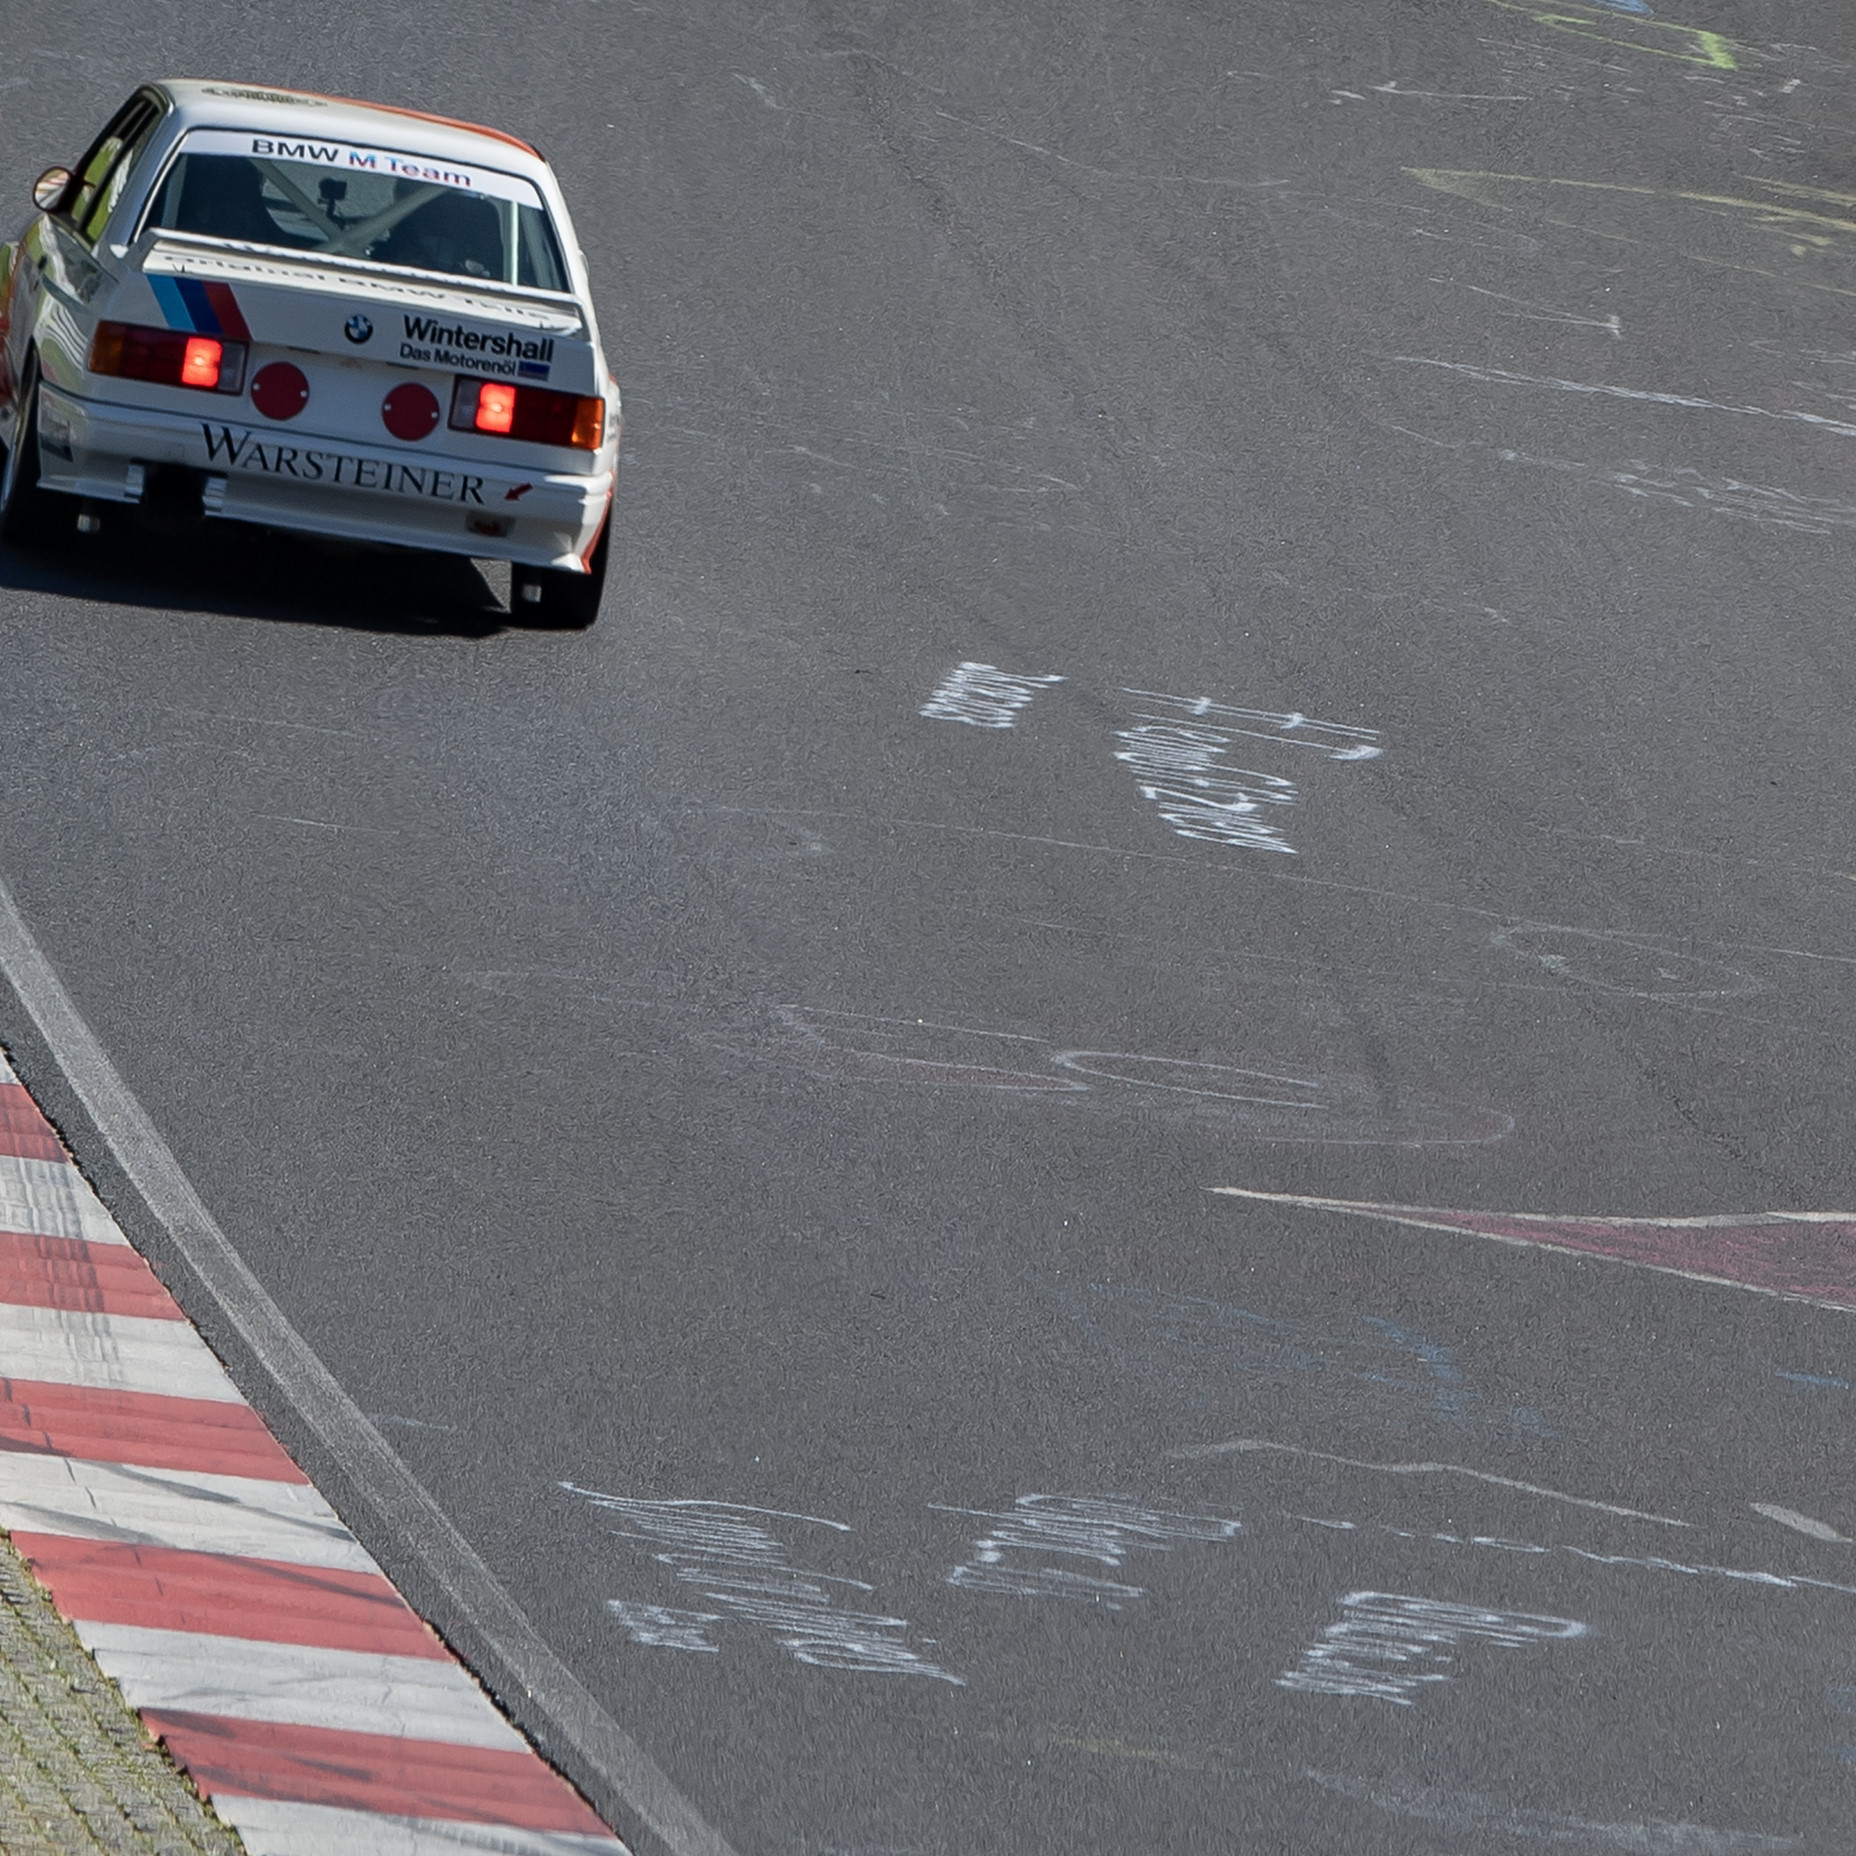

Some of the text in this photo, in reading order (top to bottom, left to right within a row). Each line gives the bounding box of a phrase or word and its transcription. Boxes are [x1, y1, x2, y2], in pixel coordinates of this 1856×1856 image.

[251, 138, 472, 188] BMW M Team
[399, 343, 517, 377] Das Motorenöl
[403, 313, 555, 364] Wintershall
[200, 422, 486, 506] WARSTEINER
